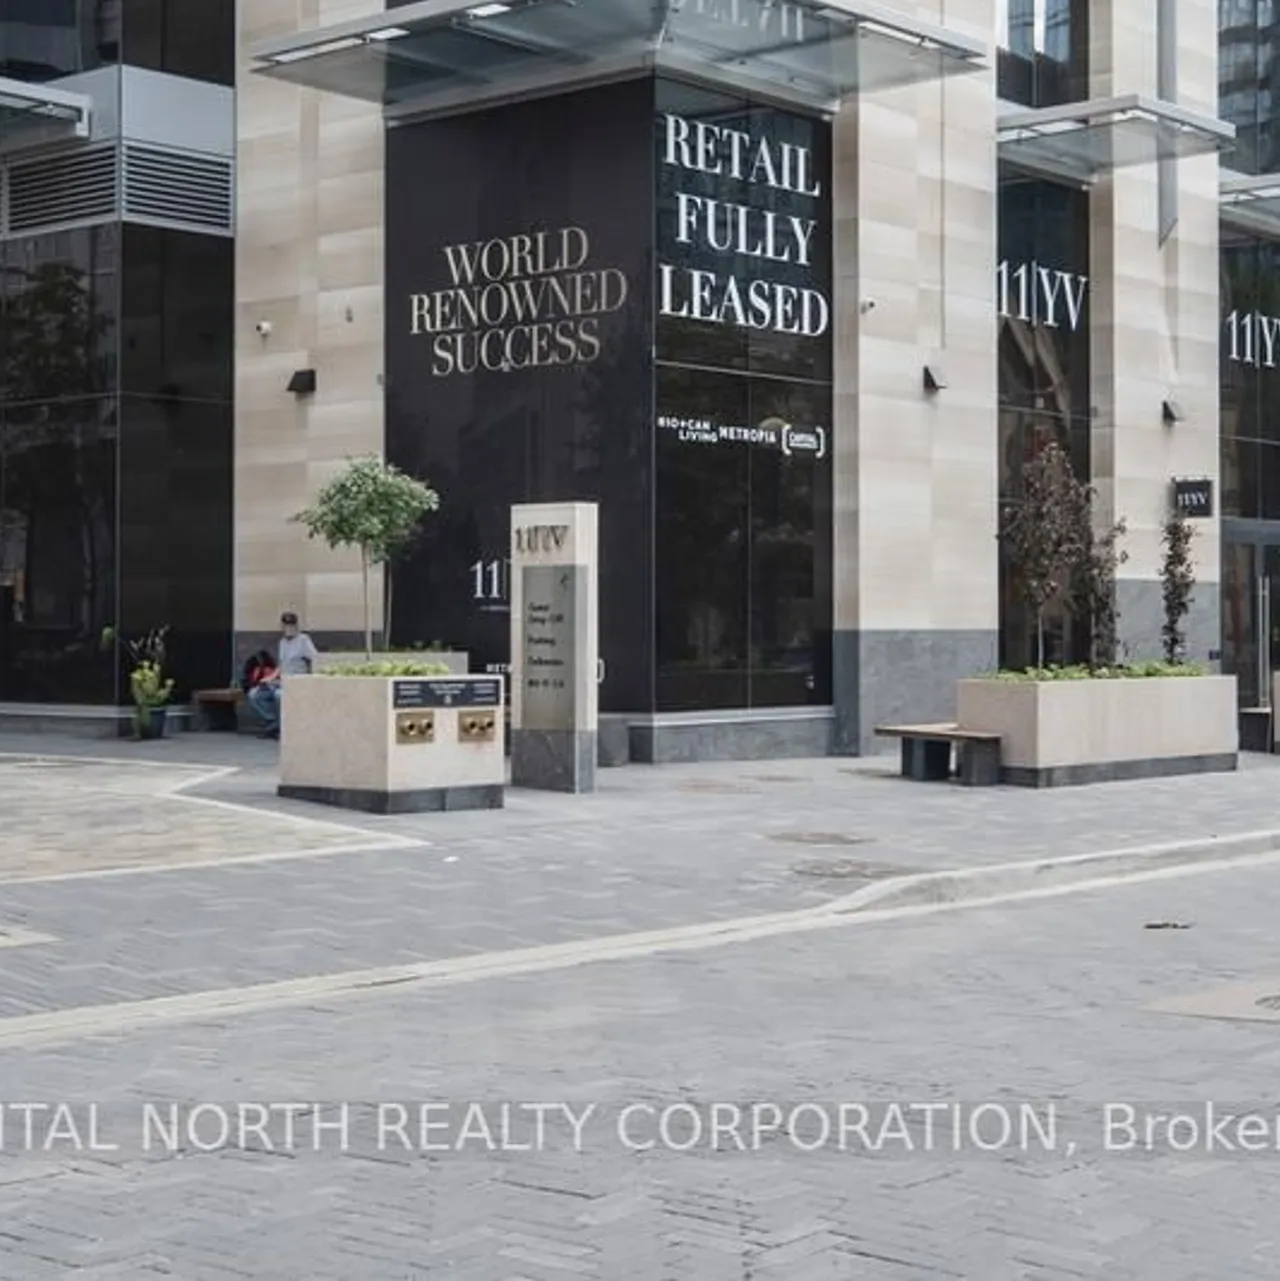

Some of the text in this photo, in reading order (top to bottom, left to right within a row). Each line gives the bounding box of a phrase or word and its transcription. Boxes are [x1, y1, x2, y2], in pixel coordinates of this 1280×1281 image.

[664, 114, 821, 197] RETAIL
[444, 226, 588, 286] WORLD
[675, 191, 817, 266] FULLY
[409, 268, 628, 335] RENOWNED
[659, 263, 830, 337] LEASED
[431, 318, 601, 376] SUCCESS
